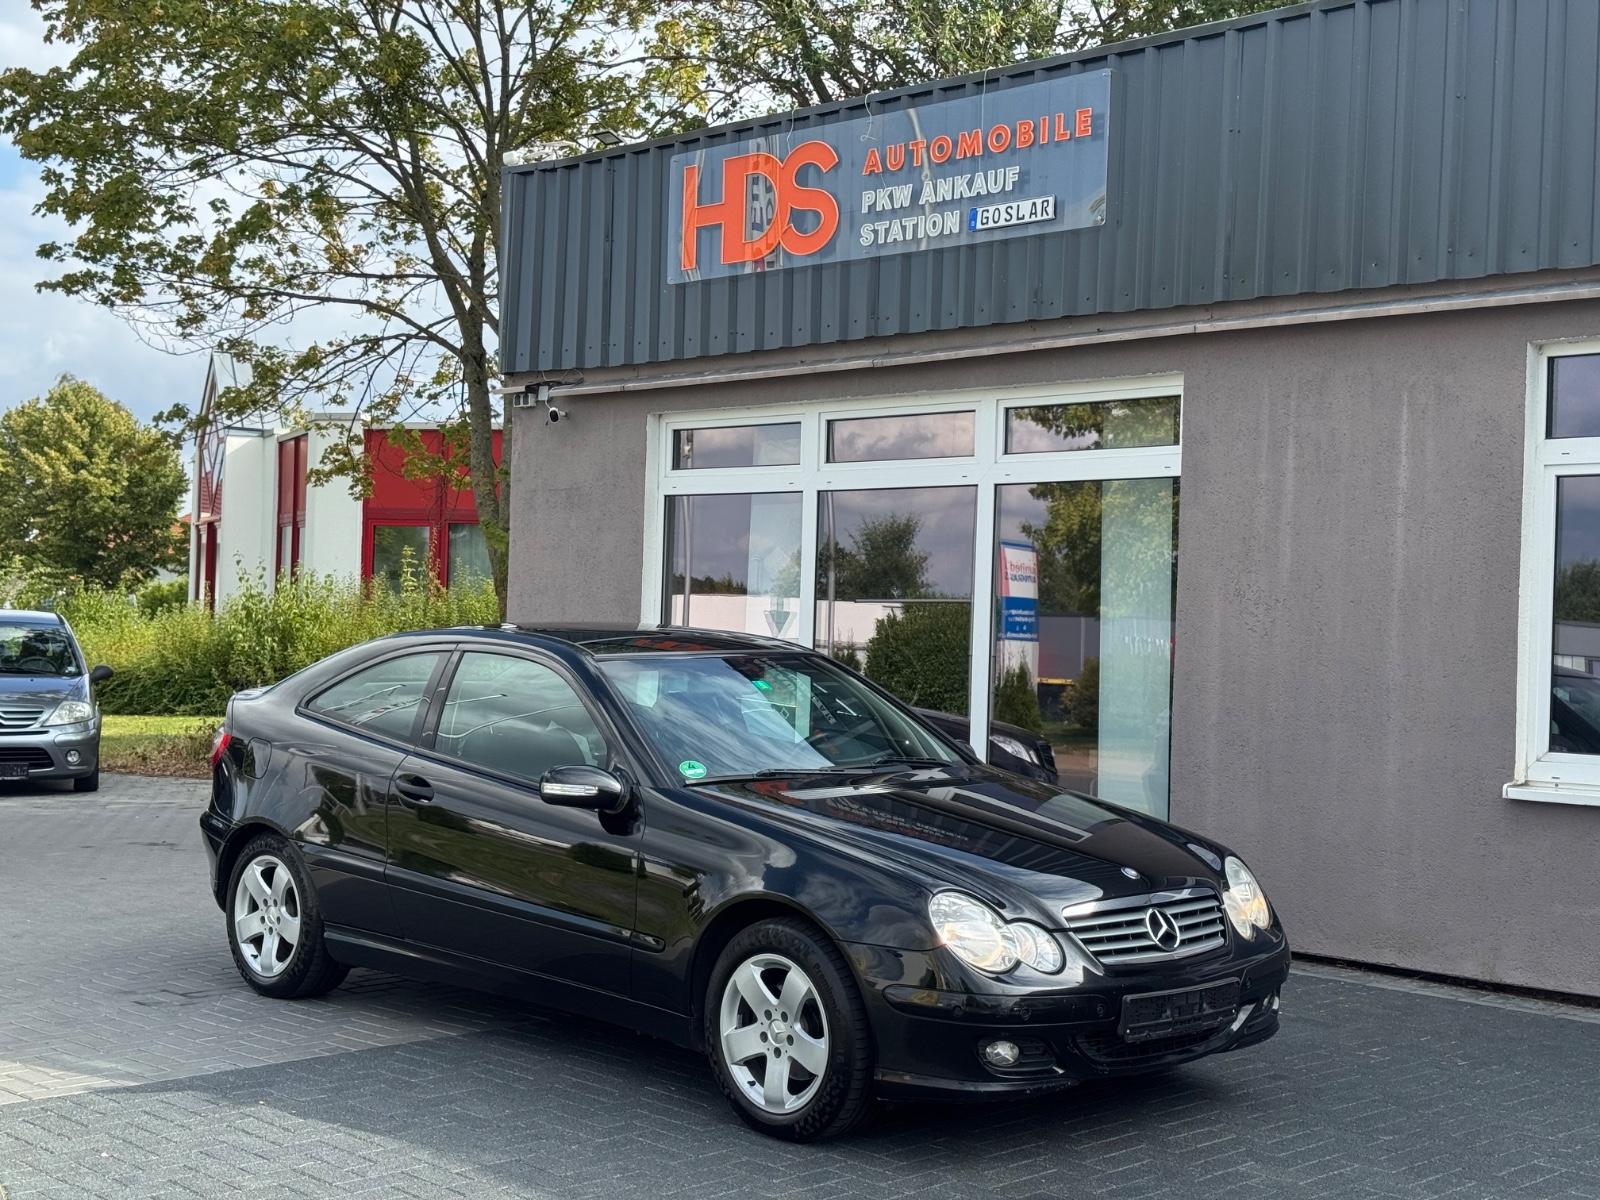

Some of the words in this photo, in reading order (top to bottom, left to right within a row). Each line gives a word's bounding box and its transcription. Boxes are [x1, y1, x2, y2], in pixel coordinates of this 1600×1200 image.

[862, 107, 1093, 176] AUTOMOBILE
[681, 140, 839, 271] HDS
[861, 183, 913, 214] PKW
[919, 166, 1020, 204] ANKAUF
[979, 199, 1051, 227] GOSLAR
[860, 209, 960, 247] STATION
